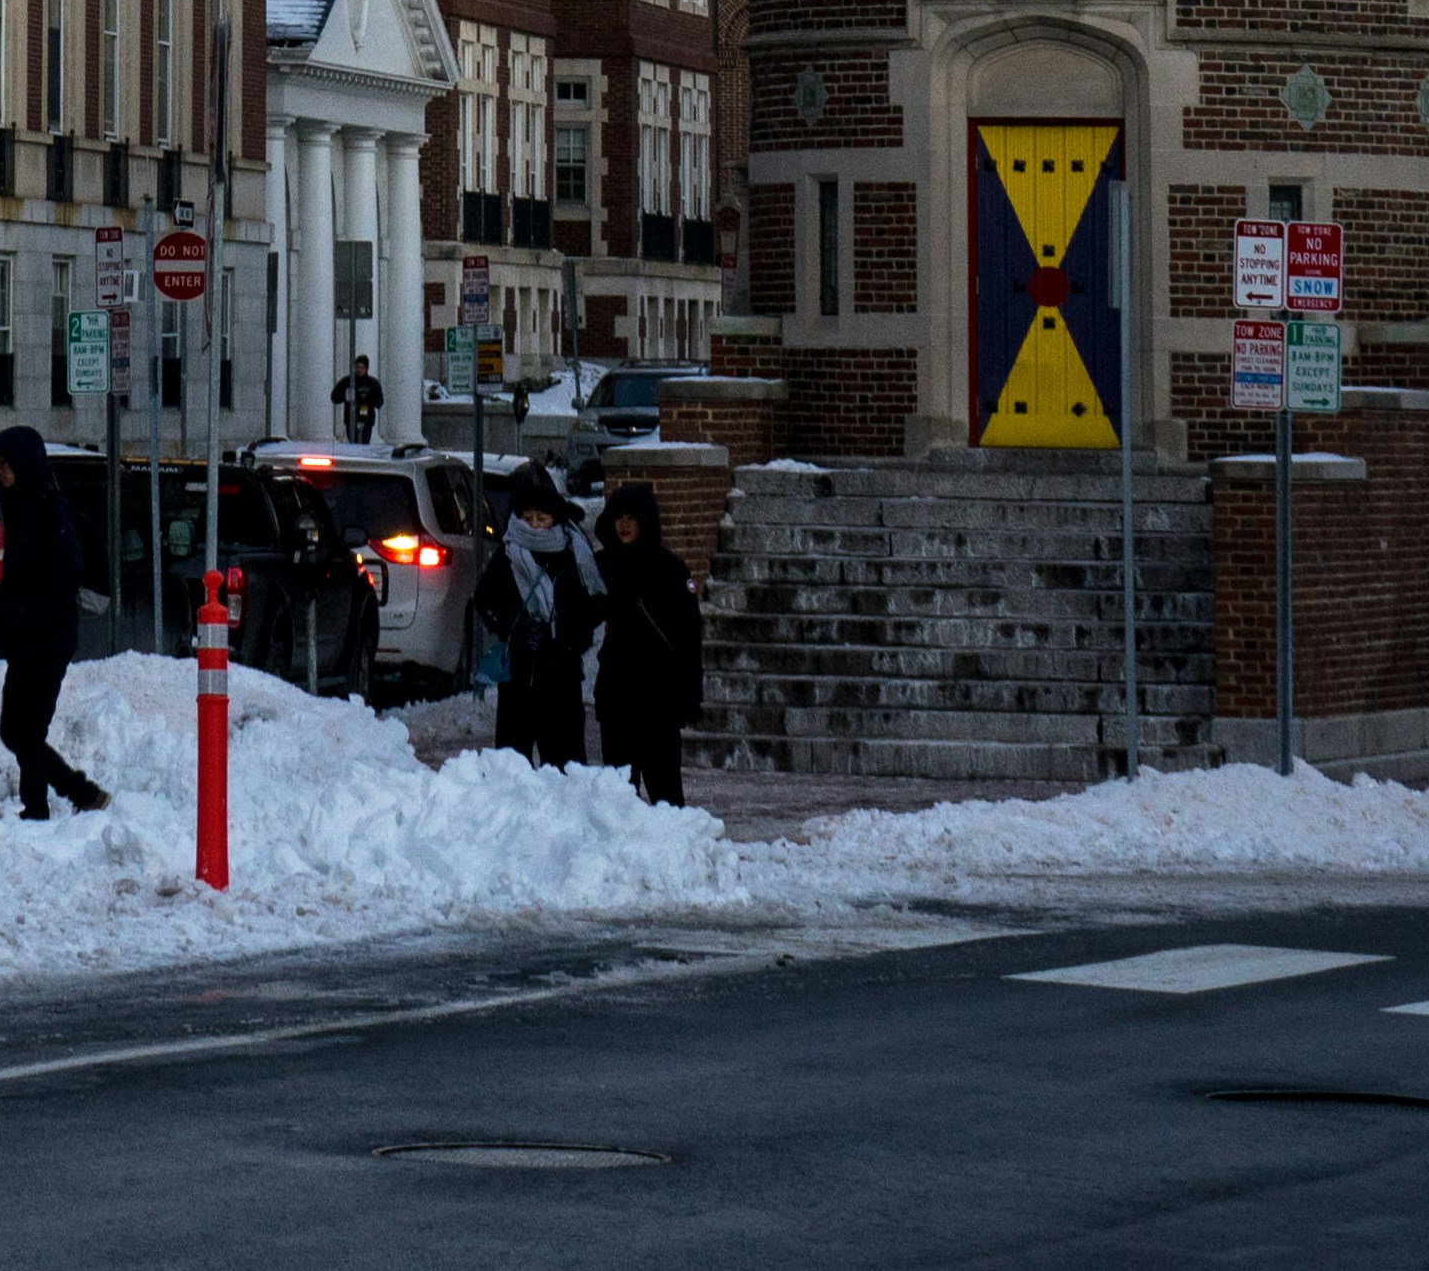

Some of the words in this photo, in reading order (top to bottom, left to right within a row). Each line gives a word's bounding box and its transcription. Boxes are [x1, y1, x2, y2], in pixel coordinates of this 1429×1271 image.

[1243, 224, 1258, 235] TOW
[1297, 225, 1311, 235] TOW
[1254, 243, 1266, 254] NO
[1306, 237, 1323, 250] NO
[160, 245, 176, 256] DO
[182, 246, 205, 257] NOT
[1240, 258, 1280, 270] STOPPING
[1289, 252, 1339, 267] PARKING
[164, 276, 202, 288] ENTER
[1241, 273, 1278, 286] ANYTIME
[1294, 280, 1334, 295] SNOW
[71, 317, 80, 338] 2
[1235, 325, 1255, 337] TOW
[1258, 326, 1283, 339] ZONE
[448, 331, 455, 349] 2
[1235, 342, 1247, 354] NO
[1249, 343, 1282, 356] PARKING
[1295, 366, 1330, 378] EXCEPT
[1291, 381, 1334, 394] SUNDAYS
